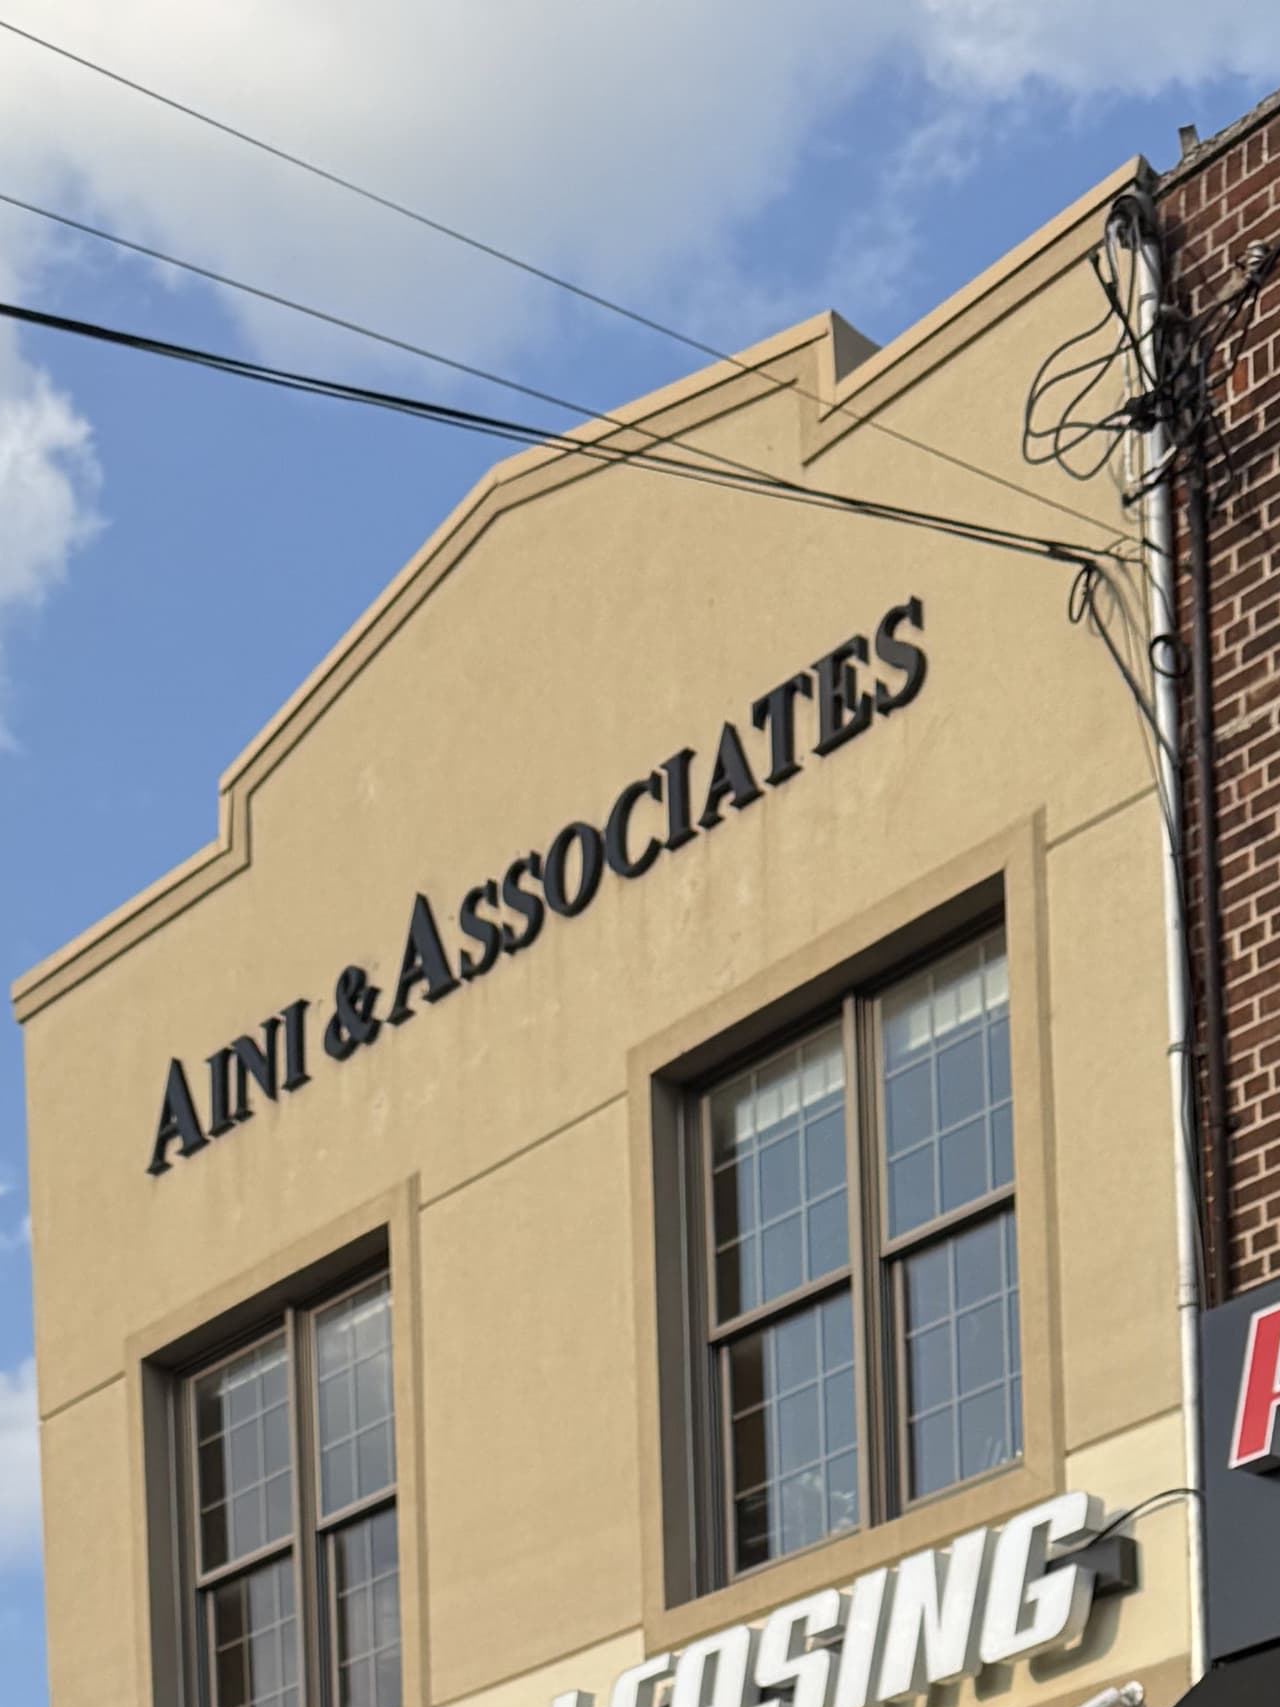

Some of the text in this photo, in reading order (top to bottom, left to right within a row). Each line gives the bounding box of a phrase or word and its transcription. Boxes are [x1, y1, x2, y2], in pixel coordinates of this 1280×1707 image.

[146, 595, 929, 1176] AINI & ASSOCIATES
